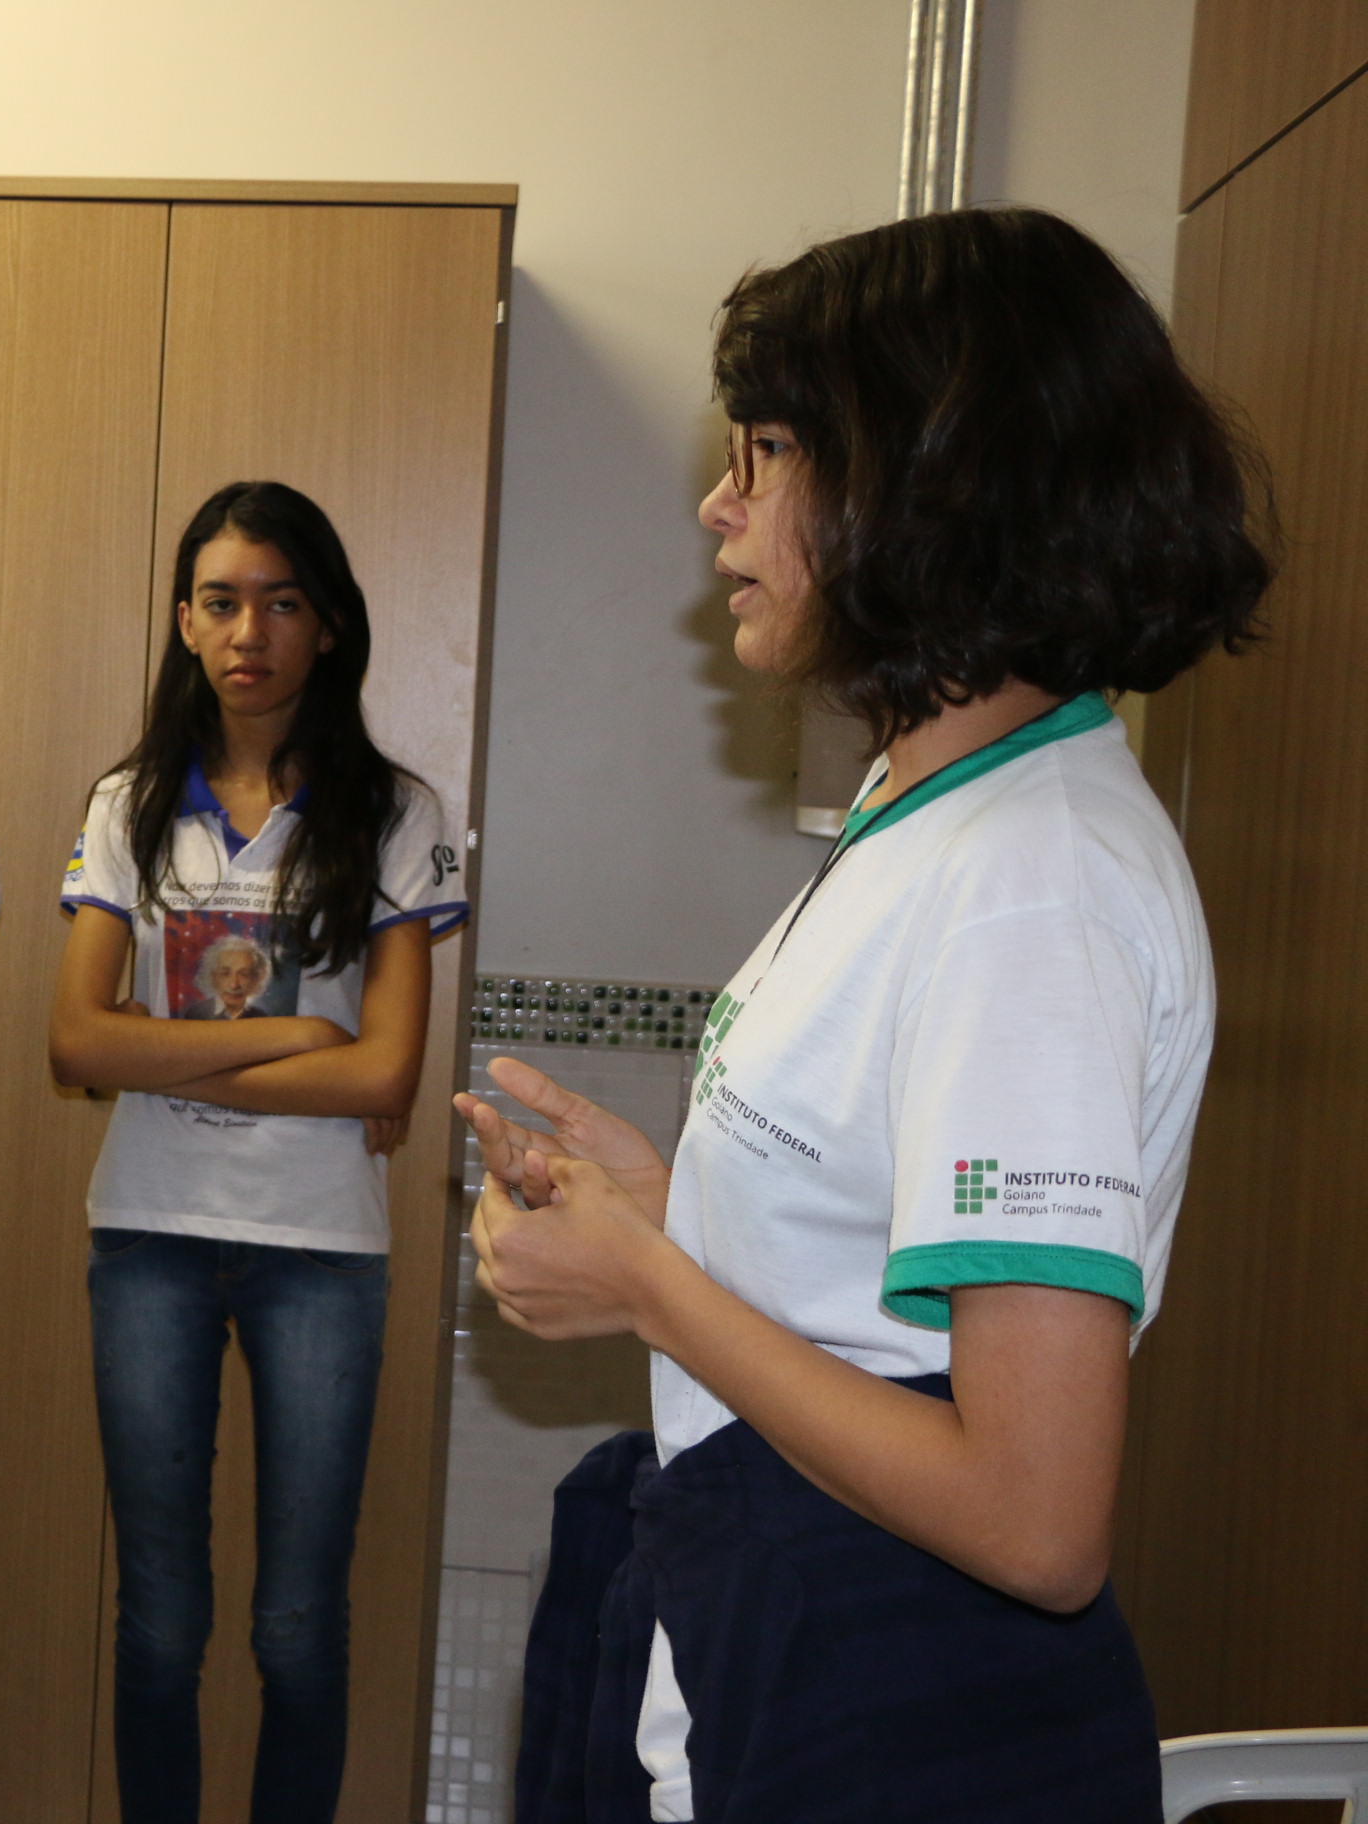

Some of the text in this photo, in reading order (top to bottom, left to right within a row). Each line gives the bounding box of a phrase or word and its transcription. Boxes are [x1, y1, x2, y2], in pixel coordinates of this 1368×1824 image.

[189, 882, 241, 891] devemos
[244, 883, 270, 892] dizer
[214, 897, 250, 906] somos
[253, 898, 266, 907] os
[712, 1096, 733, 1121] Goiano
[717, 1083, 822, 1163] INSTITUTO FEDERAL
[706, 1108, 769, 1160] Campus Trindade
[1003, 1189, 1046, 1200] Goiano
[1005, 1172, 1141, 1198] INSTITUTO FEDERAL
[1002, 1203, 1102, 1218] Campus Trindade
